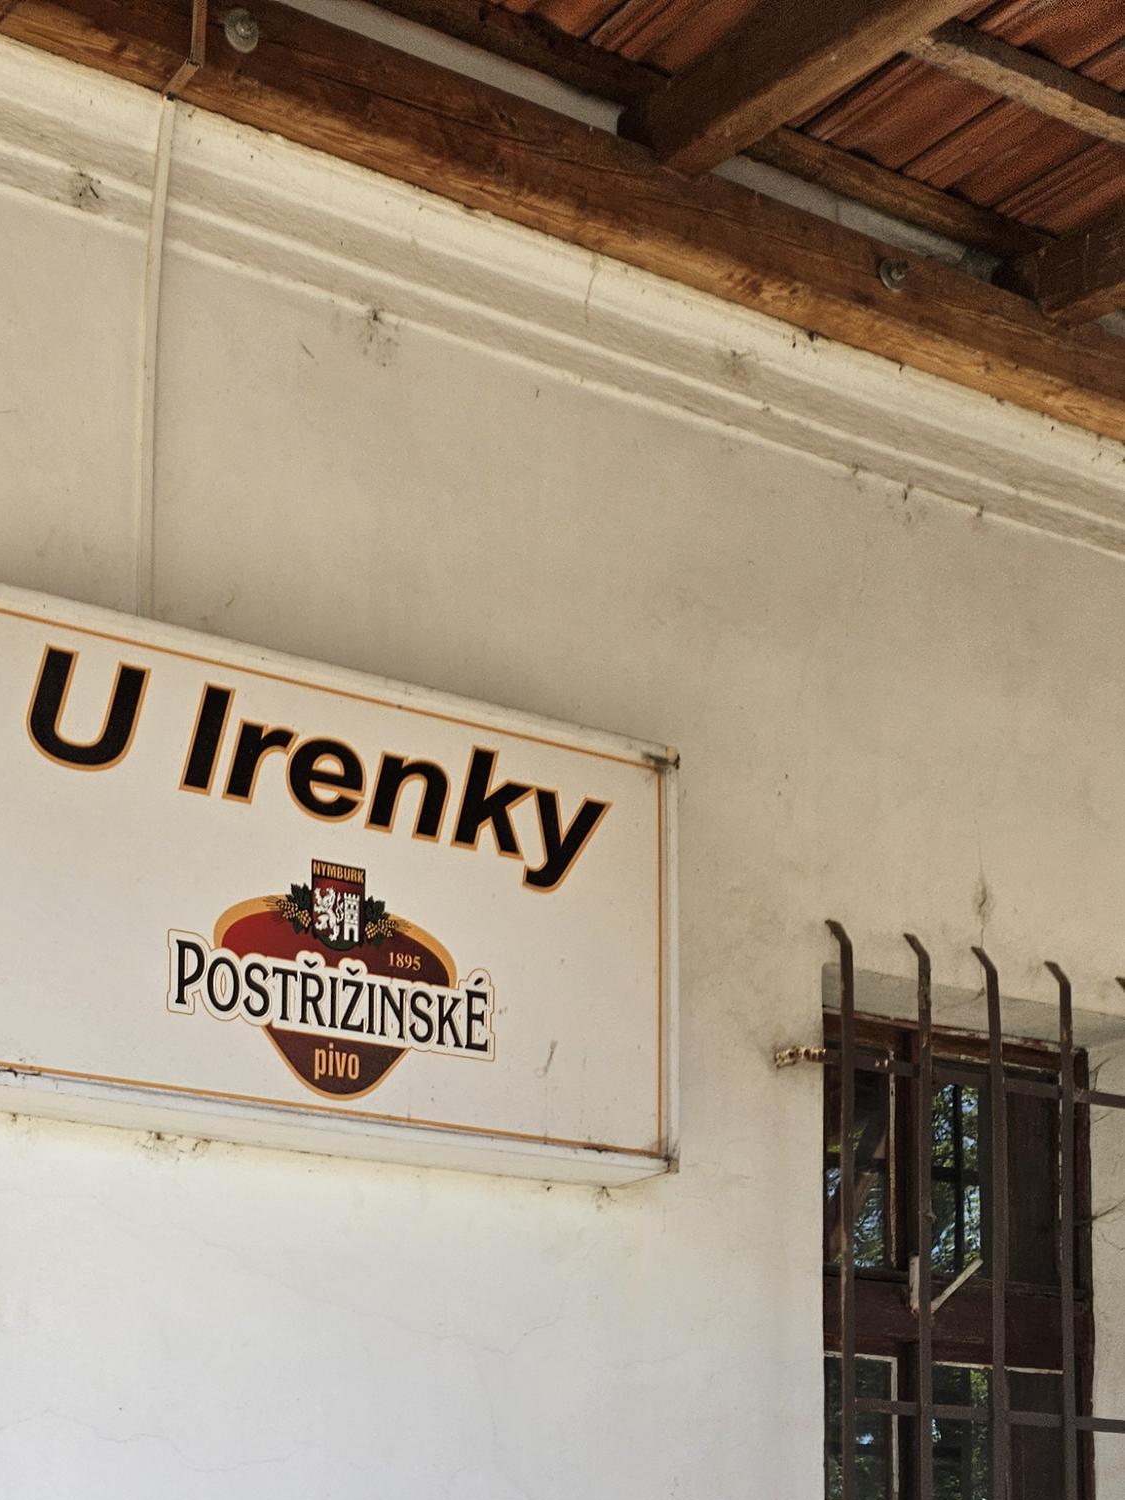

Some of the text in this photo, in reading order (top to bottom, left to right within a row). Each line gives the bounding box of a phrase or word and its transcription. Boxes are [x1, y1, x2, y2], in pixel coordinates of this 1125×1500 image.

[26, 644, 612, 893] U Irenky
[312, 860, 365, 884] NYMBURK
[388, 951, 422, 971] 1895
[174, 938, 490, 1053] POSTŘIŽINSKÉ
[314, 1041, 361, 1081] pivo
